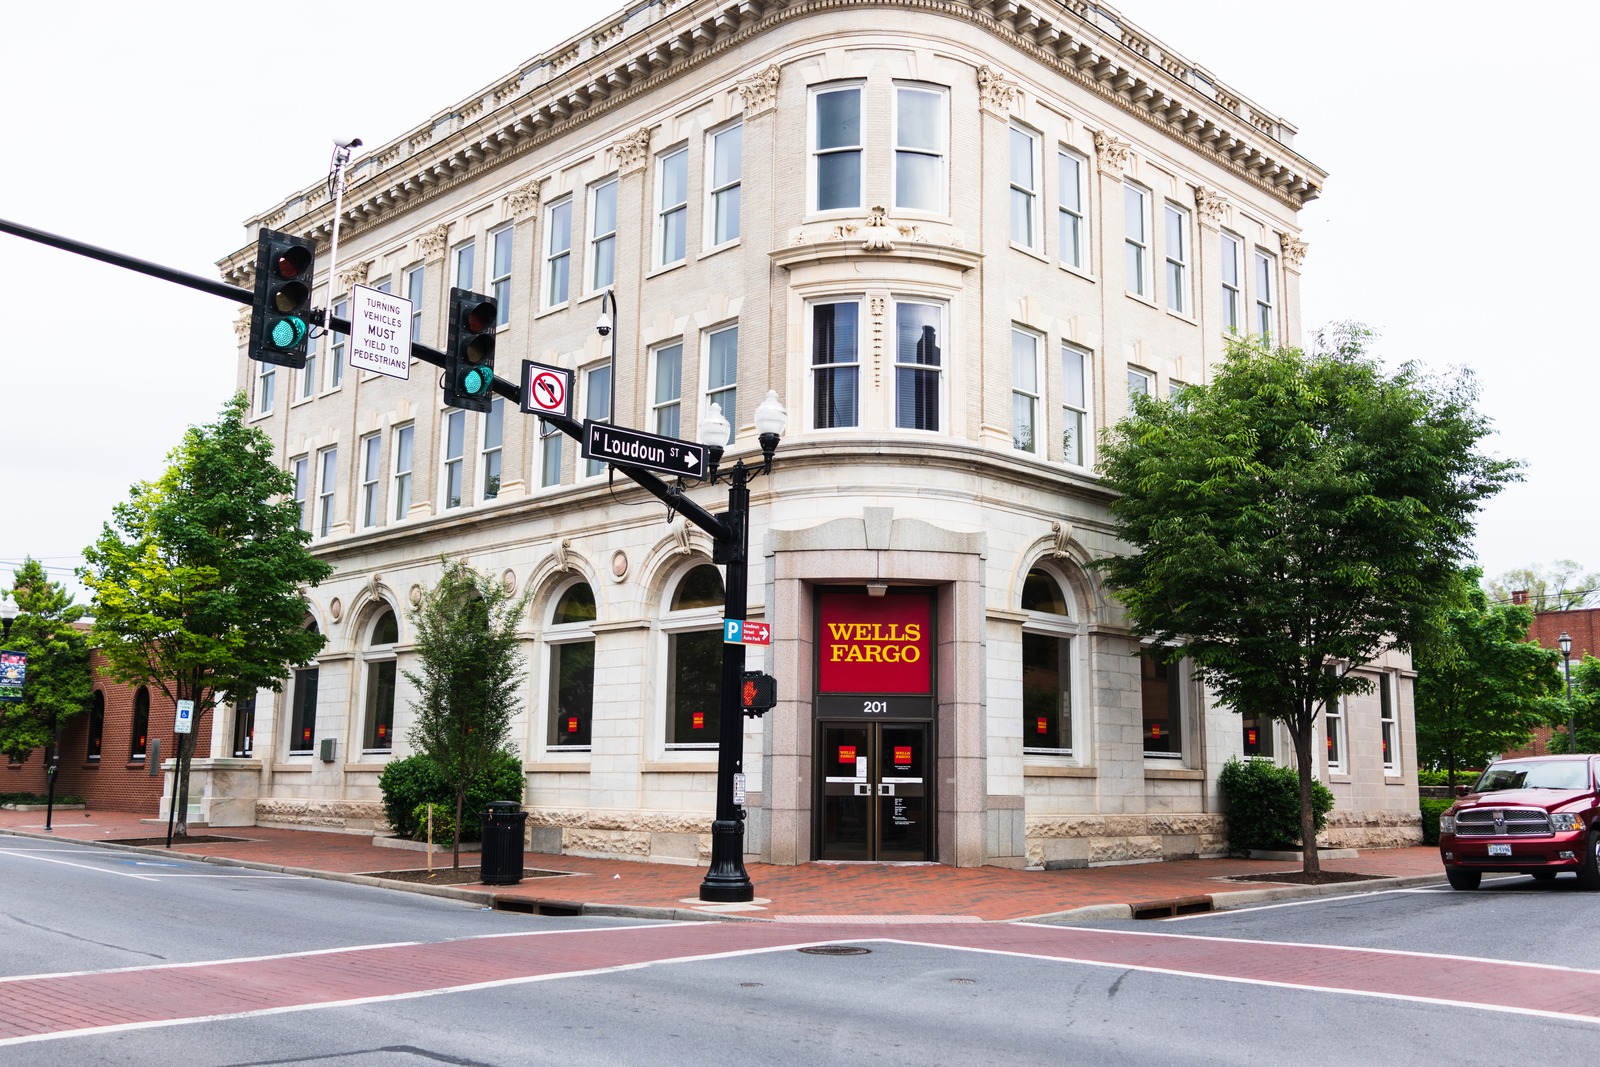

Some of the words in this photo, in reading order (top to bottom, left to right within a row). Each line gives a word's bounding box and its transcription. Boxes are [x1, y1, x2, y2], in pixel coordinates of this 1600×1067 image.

[366, 298, 400, 315] TURNING
[364, 310, 402, 328] VEHICLES
[368, 324, 395, 340] MUST
[364, 338, 386, 352] YIELD
[390, 345, 399, 355] TO
[354, 348, 406, 370] PEDESTRIANS
[594, 431, 600, 441] N
[604, 434, 665, 463] Loudoun
[670, 447, 680, 458] ST
[728, 622, 739, 639] P
[827, 623, 921, 641] WELLS
[830, 644, 920, 663] FARGO
[863, 701, 887, 713] 201
